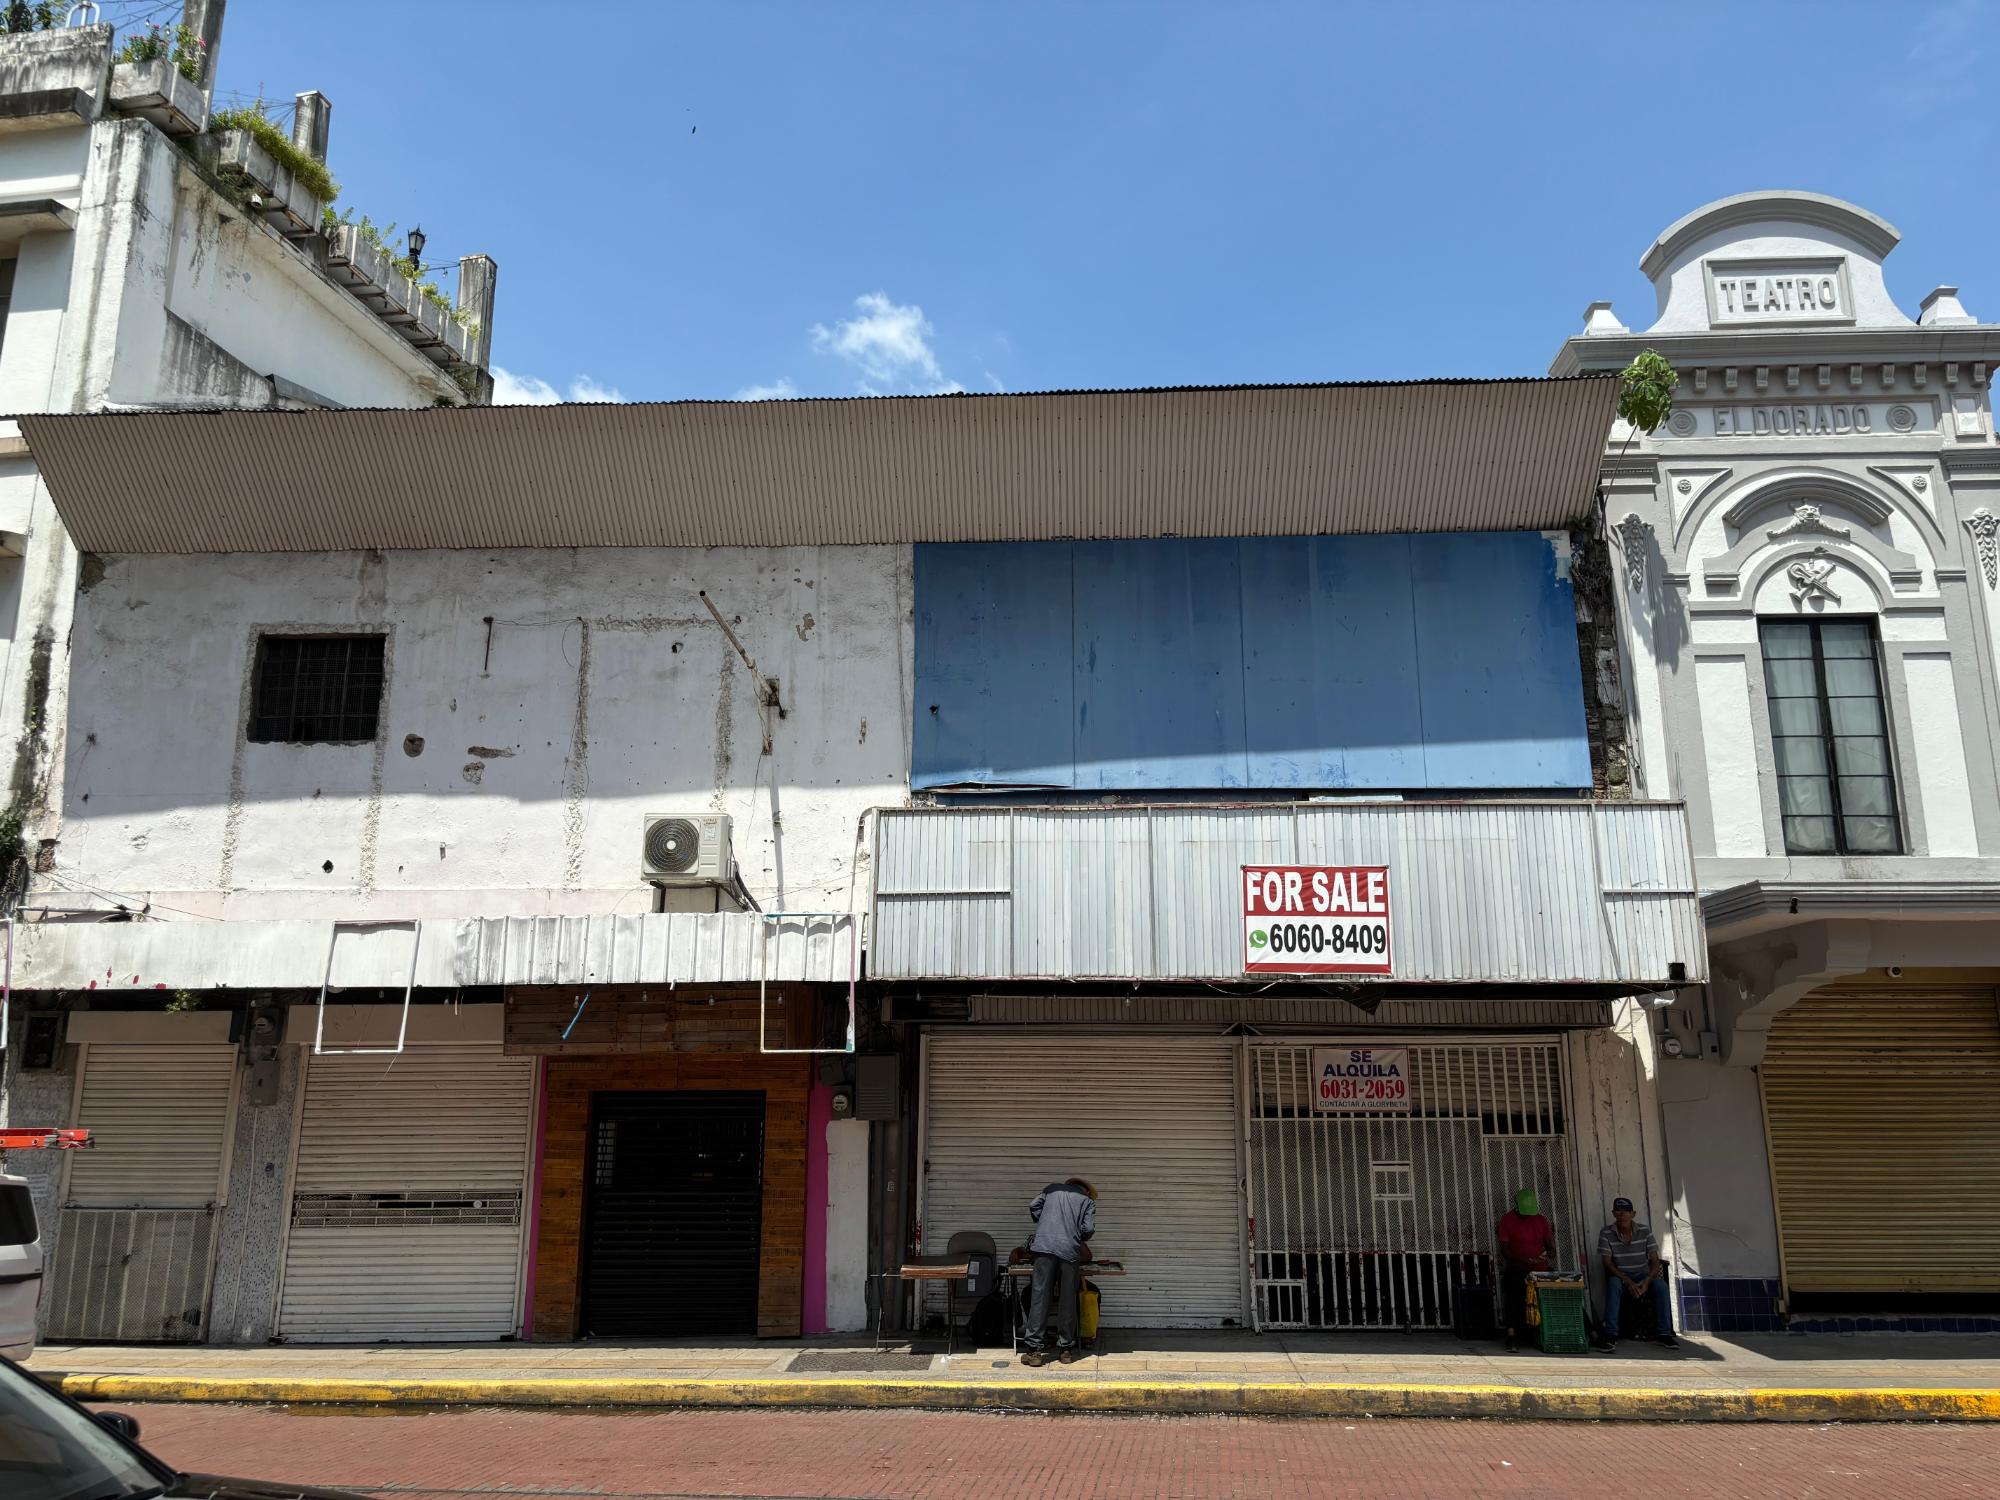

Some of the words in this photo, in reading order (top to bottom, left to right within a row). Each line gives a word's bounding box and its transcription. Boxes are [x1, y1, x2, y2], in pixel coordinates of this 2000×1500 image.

[1720, 277, 1836, 312] TEATRO
[1713, 406, 1752, 436] EL
[1753, 404, 1872, 436] DORADO
[1246, 871, 1304, 912] FOR
[1312, 871, 1385, 912] SALE
[1269, 923, 1386, 954] 6060-8409
[1350, 1050, 1372, 1062] SE
[1323, 1064, 1400, 1077] ALQUILA
[1320, 1079, 1405, 1099] 6031-2059
[1320, 1100, 1360, 1108] CONTACTAR
[1367, 1100, 1408, 1108] GLORYBETH
